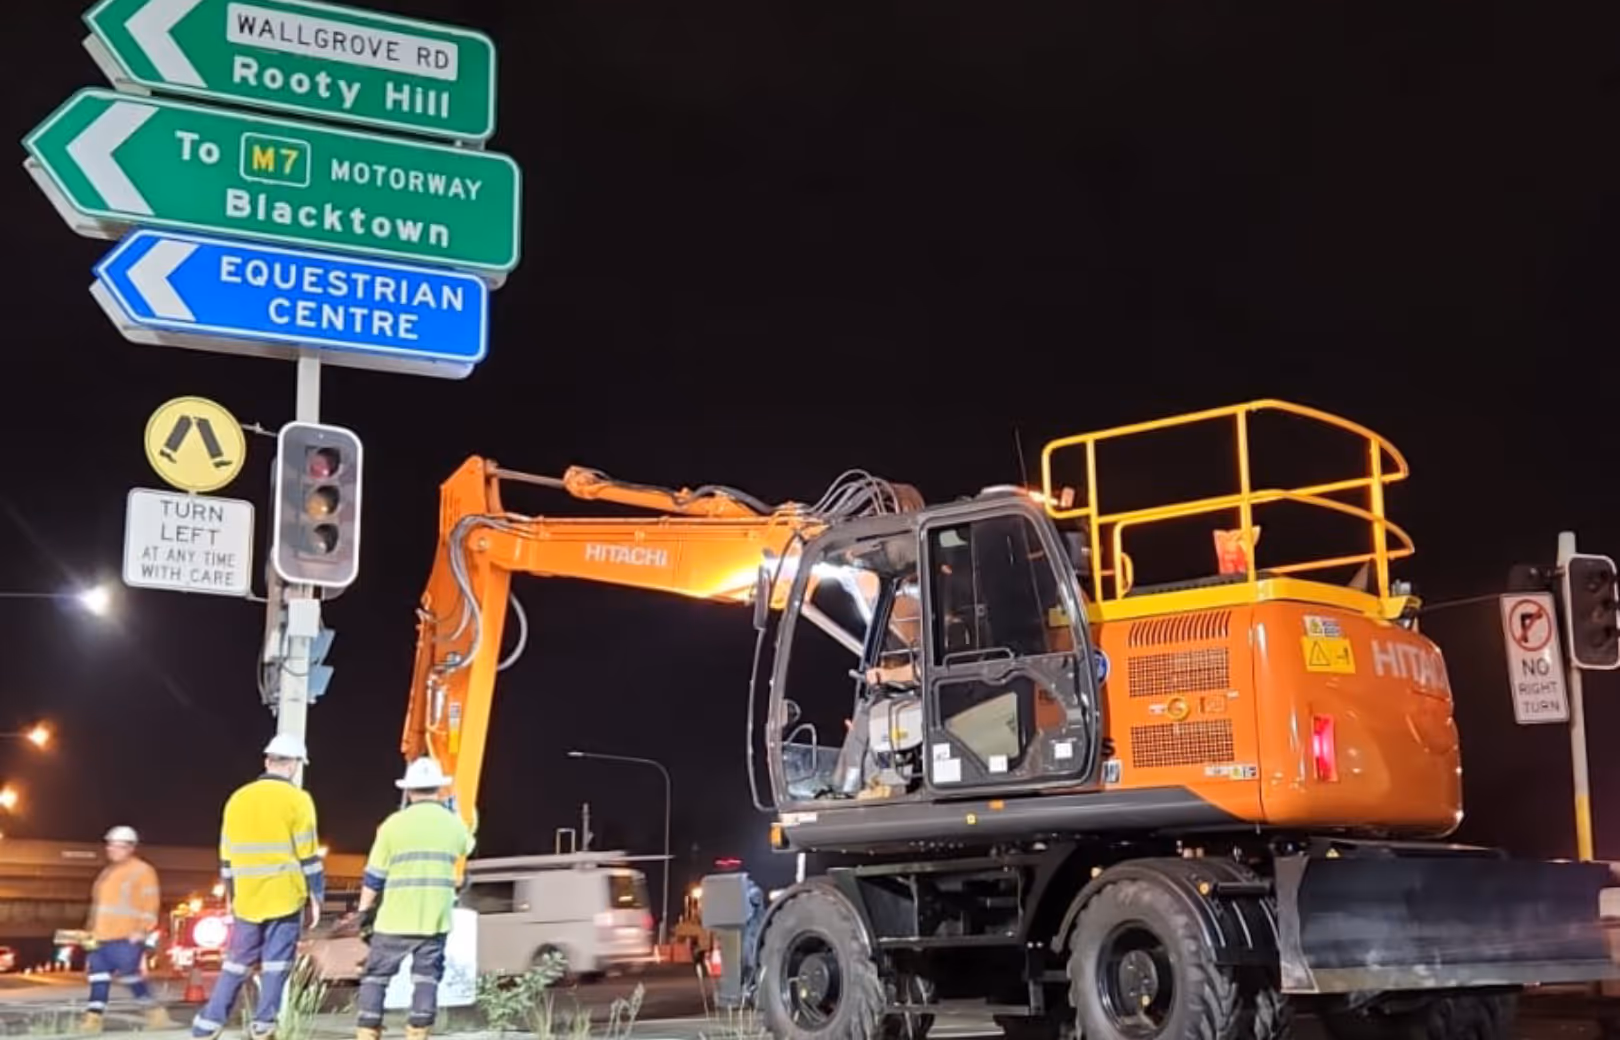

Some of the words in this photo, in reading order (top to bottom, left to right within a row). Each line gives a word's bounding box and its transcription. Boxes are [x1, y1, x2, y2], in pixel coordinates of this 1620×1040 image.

[237, 12, 400, 62] WALLGROVE
[416, 46, 450, 71] RD
[232, 55, 361, 109] Rooty
[385, 82, 450, 119] Hill
[175, 130, 221, 165] To
[251, 144, 299, 175] M7
[330, 158, 482, 201] MOTORWAY
[225, 188, 450, 249] Blacktown
[220, 255, 465, 312] EQUESTRIAN
[268, 297, 420, 341] CENTRE
[160, 499, 224, 523] TURN
[160, 522, 221, 546] LEFT
[141, 545, 159, 562] AT
[166, 548, 196, 564] ANY
[203, 551, 237, 569] TIME
[585, 543, 668, 567] HITACHI
[141, 563, 181, 581] WITH
[189, 568, 235, 587] CARE
[1521, 657, 1550, 677] NO
[1519, 681, 1557, 696] RIGHT
[1522, 699, 1560, 714] TURN
